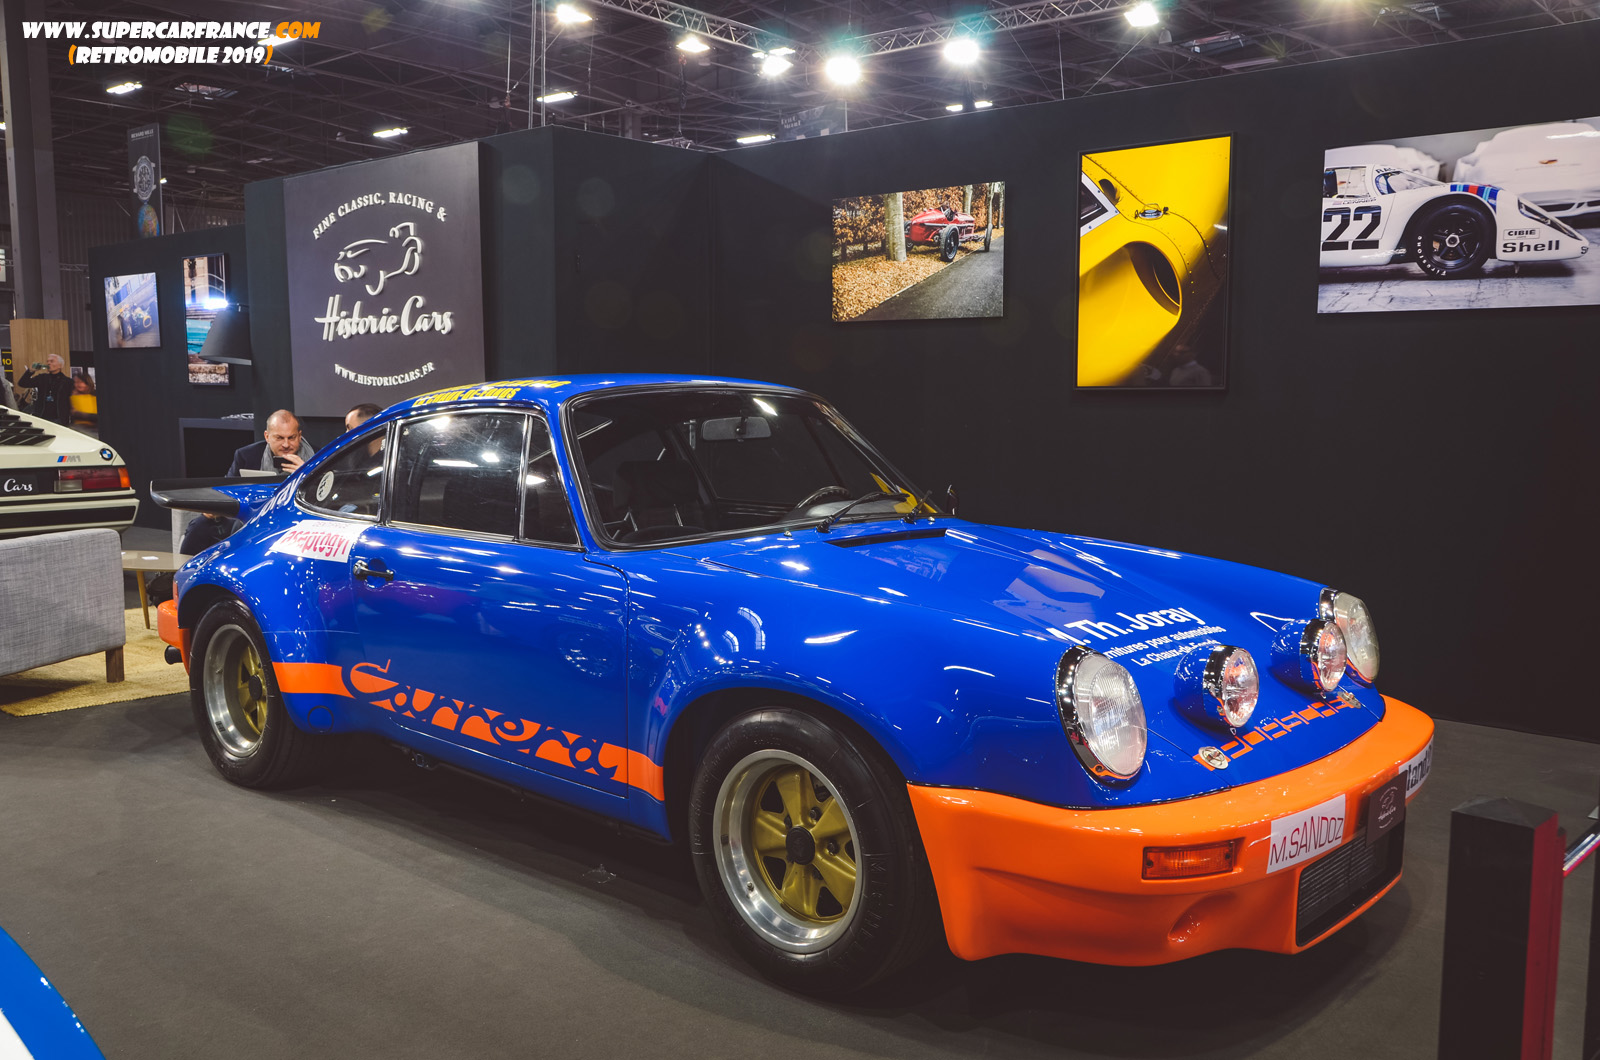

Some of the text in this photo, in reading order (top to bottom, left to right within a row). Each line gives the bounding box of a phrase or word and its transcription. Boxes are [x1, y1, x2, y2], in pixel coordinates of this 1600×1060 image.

[312, 192, 447, 240] FINE CLASSIC, RACING &
[1322, 205, 1382, 251] 22
[1507, 229, 1536, 237] CIBIE
[1502, 240, 1560, 253] Shell
[314, 294, 454, 341] Historic Cars
[334, 362, 435, 387] WWW.HISTORICCARS.FR
[4, 478, 33, 492] Cars
[1145, 636, 1173, 648] pour
[1131, 658, 1153, 666] La
[342, 659, 628, 783] Carrera
[1270, 816, 1344, 866] M.SANDOZ
